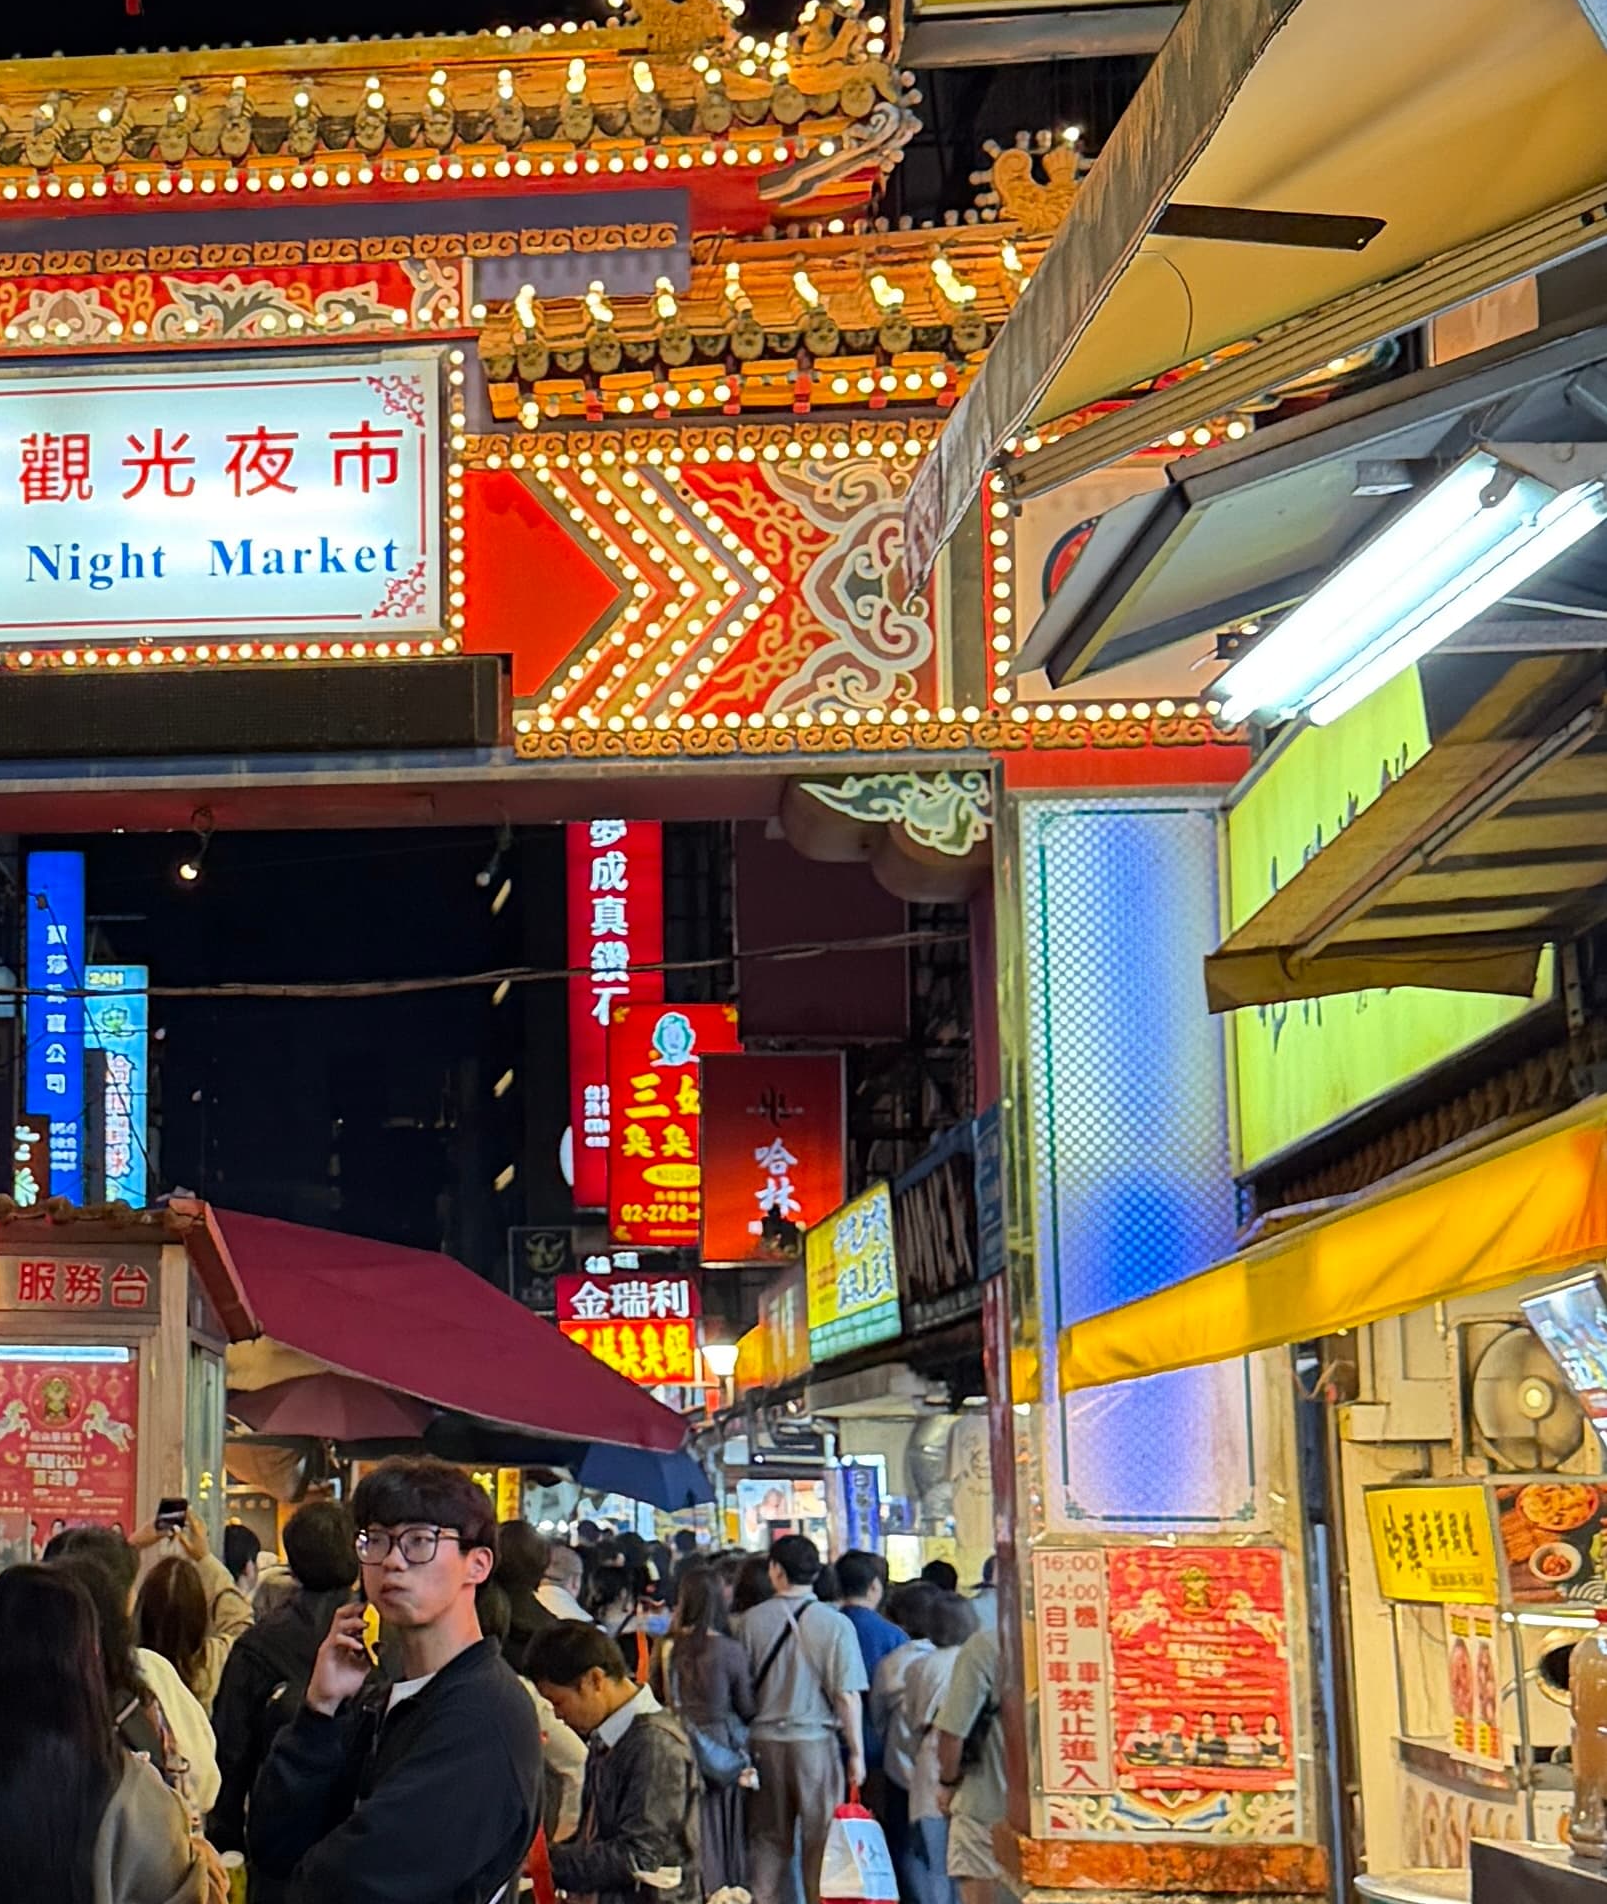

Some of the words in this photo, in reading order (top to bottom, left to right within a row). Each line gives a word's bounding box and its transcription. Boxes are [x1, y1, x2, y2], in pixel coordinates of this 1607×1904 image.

[25, 541, 167, 591] Night
[209, 536, 401, 577] Market
[750, 1137, 804, 1231] 哈林
[18, 1261, 151, 1308] 服務台
[569, 1279, 691, 1320] 金瑞利
[1042, 1554, 1100, 1572] 16:00
[1042, 1583, 1100, 1601] 24:00
[1058, 1688, 1099, 1789] 禁止進入
